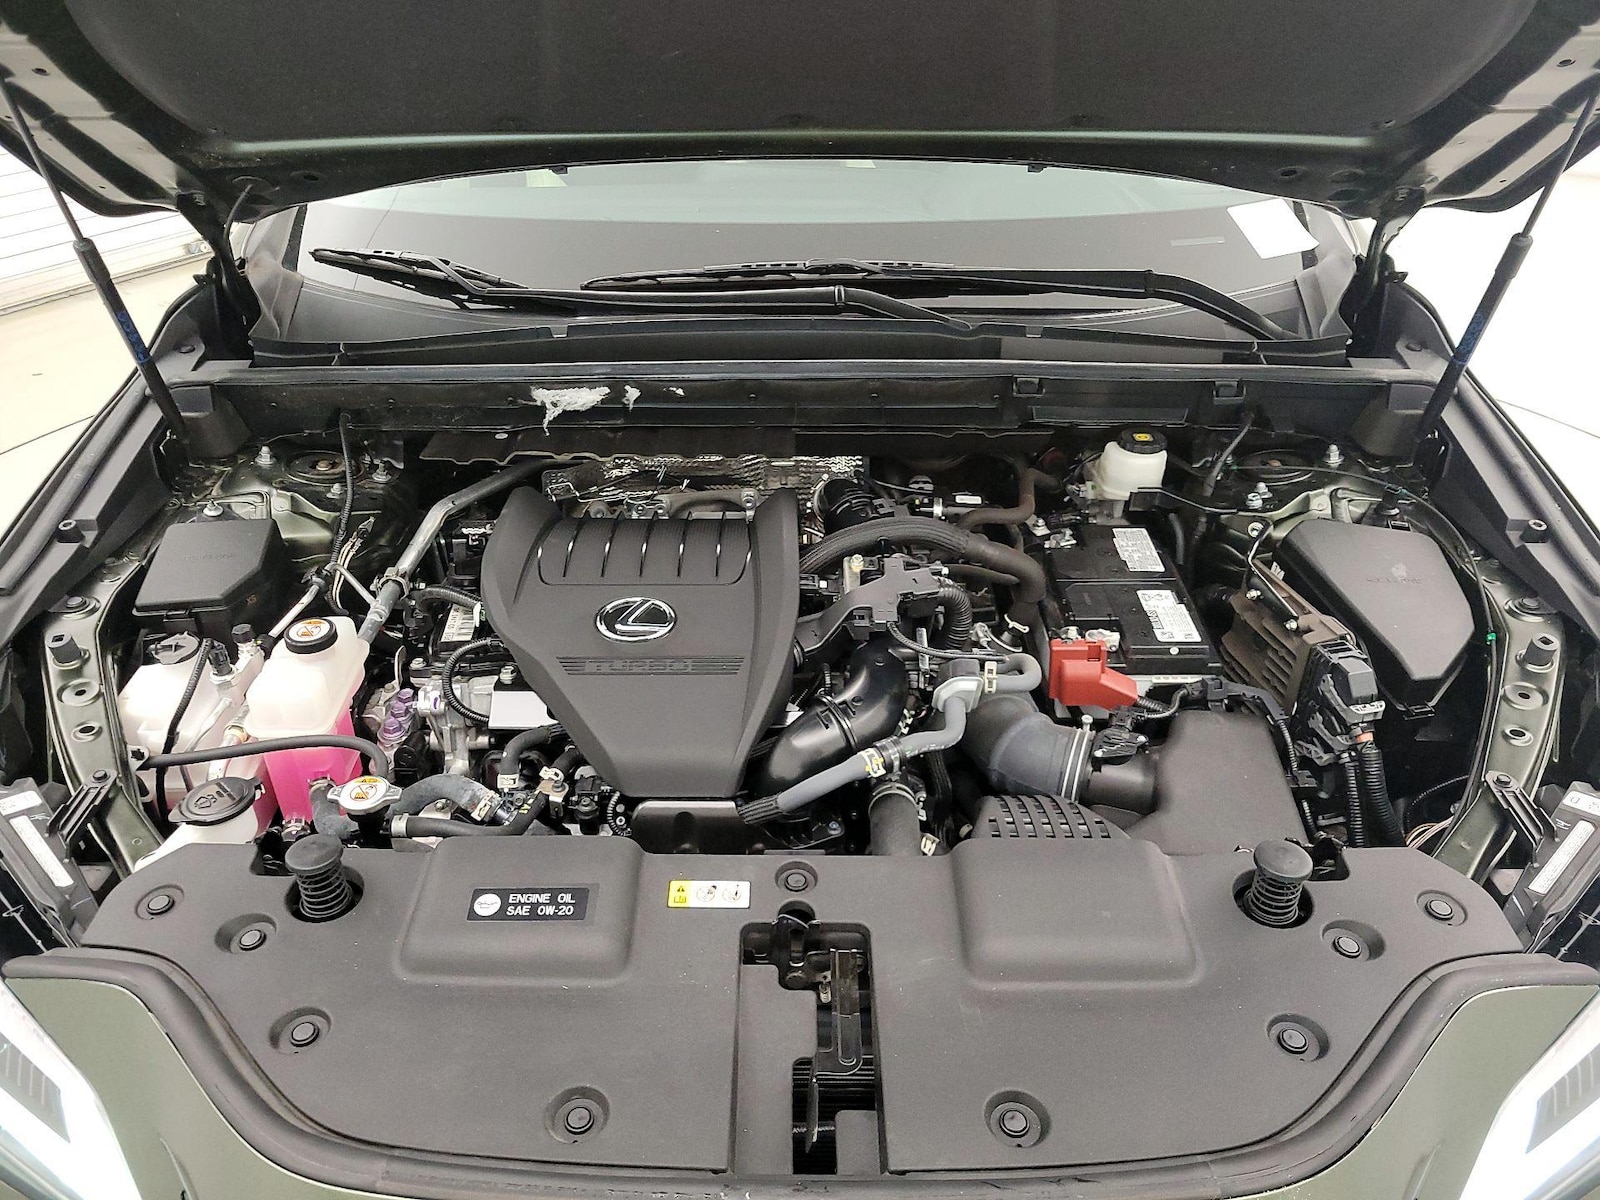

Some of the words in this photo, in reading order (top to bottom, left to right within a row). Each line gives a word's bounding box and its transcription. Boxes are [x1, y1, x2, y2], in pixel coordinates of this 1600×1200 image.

[584, 659, 692, 672] TURBO
[508, 893, 552, 904] ENGINE
[557, 893, 576, 904] OIL
[506, 905, 531, 916] SAE
[537, 905, 574, 916] 0W-20
